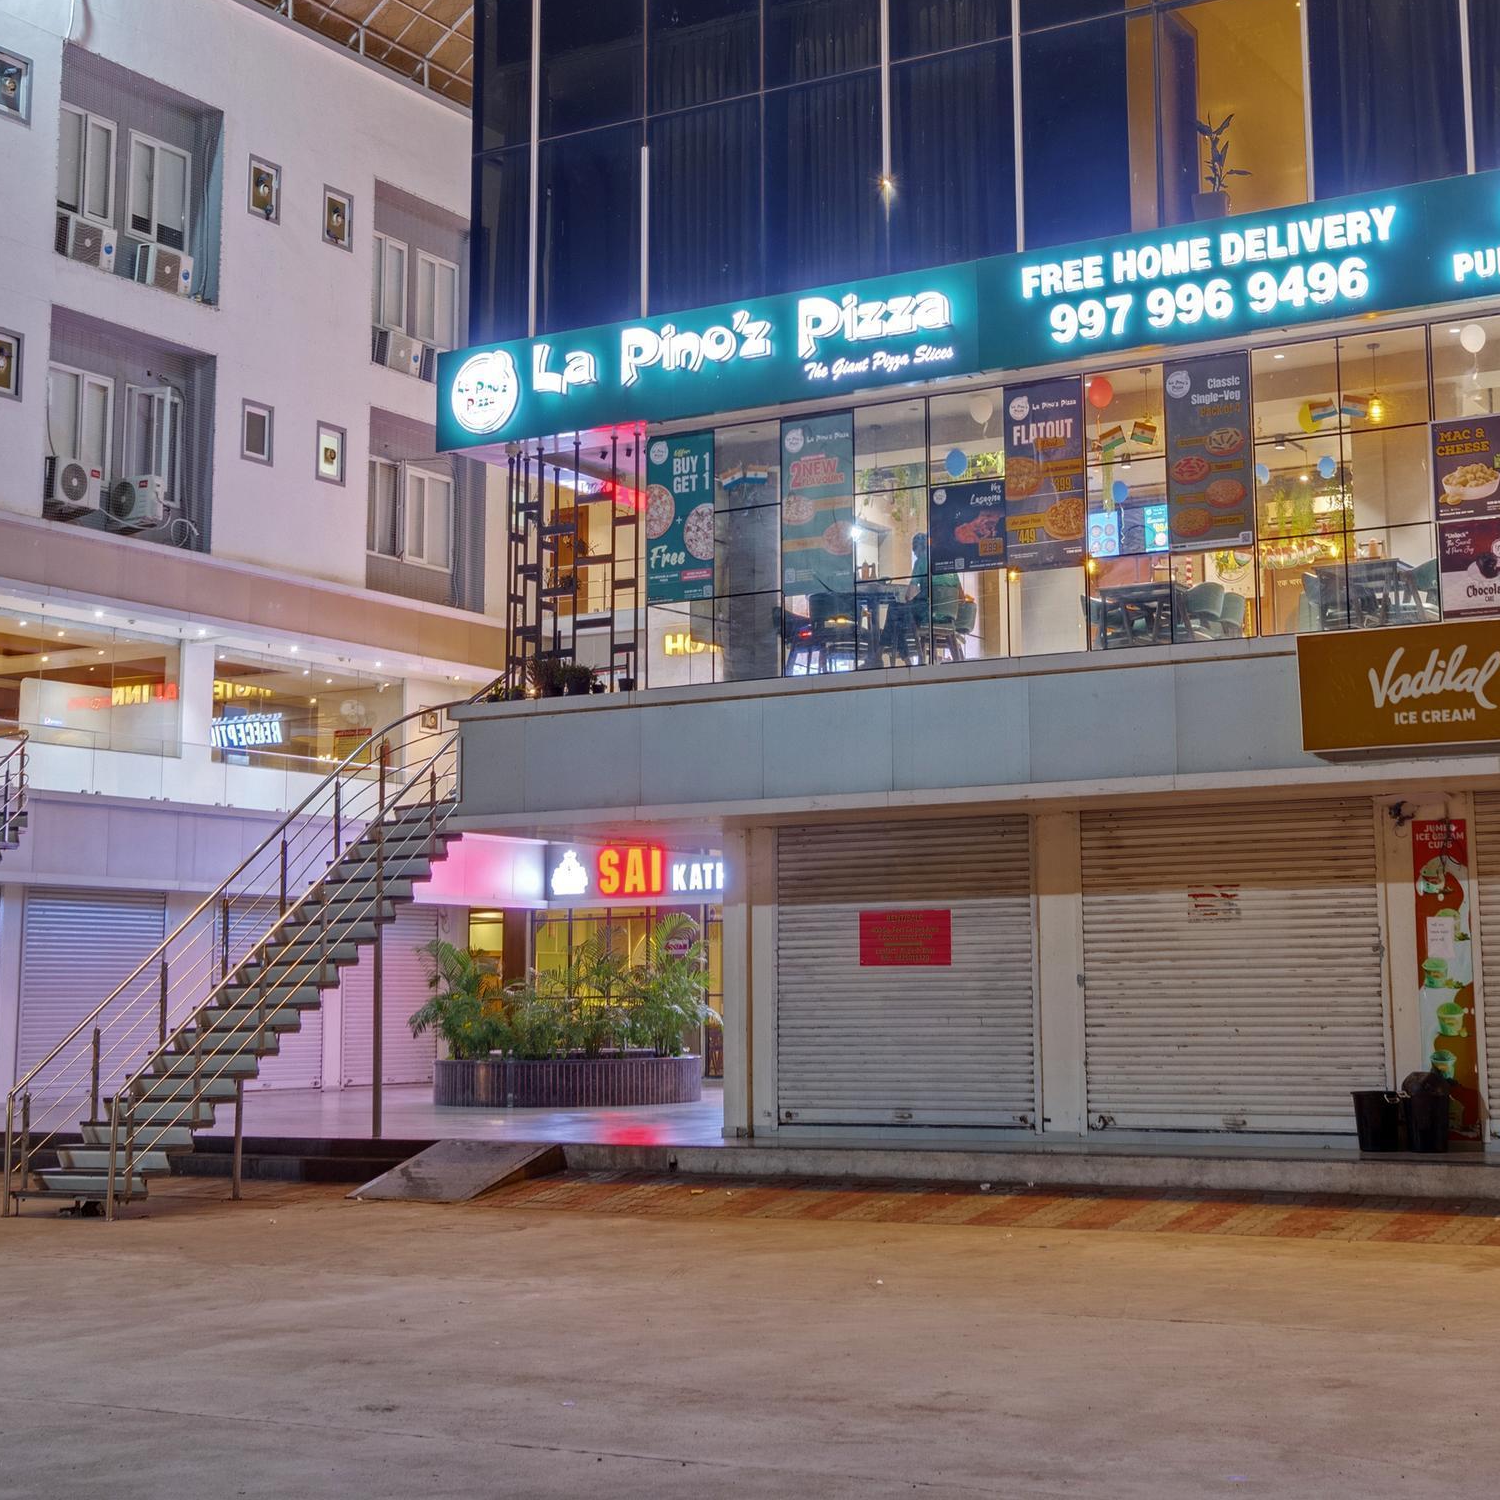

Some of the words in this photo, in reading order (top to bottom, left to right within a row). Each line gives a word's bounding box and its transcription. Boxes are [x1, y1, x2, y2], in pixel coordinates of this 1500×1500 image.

[1020, 254, 1103, 300] FREE
[1112, 234, 1212, 289] HOME
[1220, 204, 1398, 268] DELIVERY
[1048, 297, 1134, 346] 997
[1147, 275, 1234, 330] 996
[1248, 256, 1370, 316] 9496
[533, 343, 597, 396] La
[620, 310, 773, 387] Pino'z
[797, 289, 953, 359] Pizza
[804, 362, 829, 382] The
[832, 356, 870, 381] Giant
[871, 352, 911, 376] Pizza
[912, 345, 955, 368] Slices
[1207, 375, 1240, 389] Classic
[1013, 418, 1073, 446] FLATOUT
[1440, 430, 1471, 442] MAC
[1475, 428, 1485, 438] &
[1436, 440, 1490, 456] CHEESE
[673, 456, 698, 475] BUY
[703, 452, 710, 472] 1
[791, 463, 801, 488] 2
[803, 459, 837, 477] NEW
[673, 475, 698, 494] GET
[703, 472, 710, 490] 1
[650, 545, 685, 569] Free
[1368, 643, 1500, 710] Vadilal
[1394, 710, 1427, 726] ICE
[1429, 706, 1477, 724] CREAM
[1416, 833, 1430, 841] ICE
[599, 848, 662, 894] SAI
